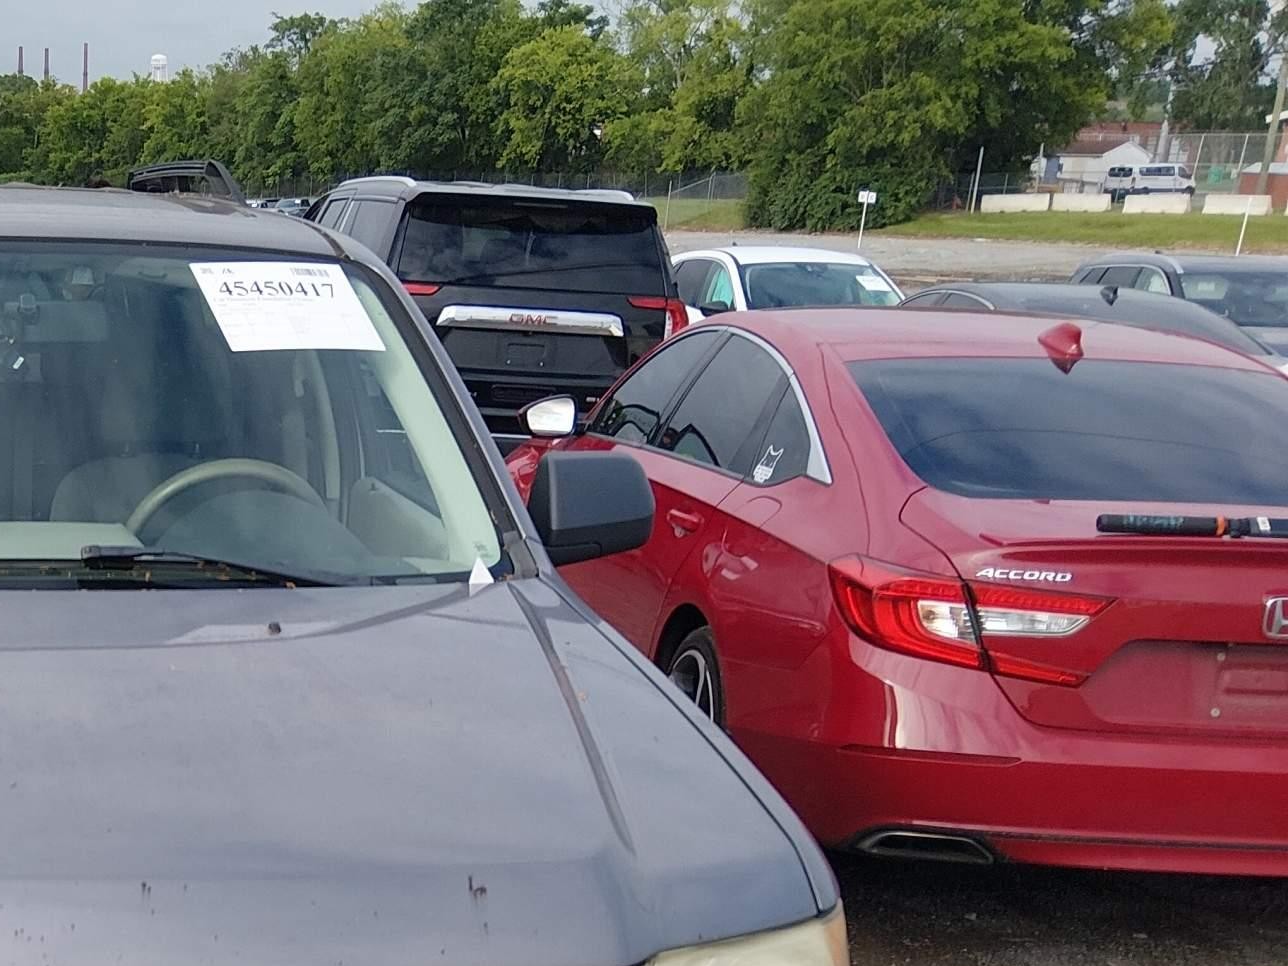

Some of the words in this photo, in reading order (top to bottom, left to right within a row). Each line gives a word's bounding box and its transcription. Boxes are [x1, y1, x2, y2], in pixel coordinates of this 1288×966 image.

[219, 280, 334, 298] 45450417
[509, 313, 558, 325] GMC
[975, 567, 1073, 582] ACCORD
